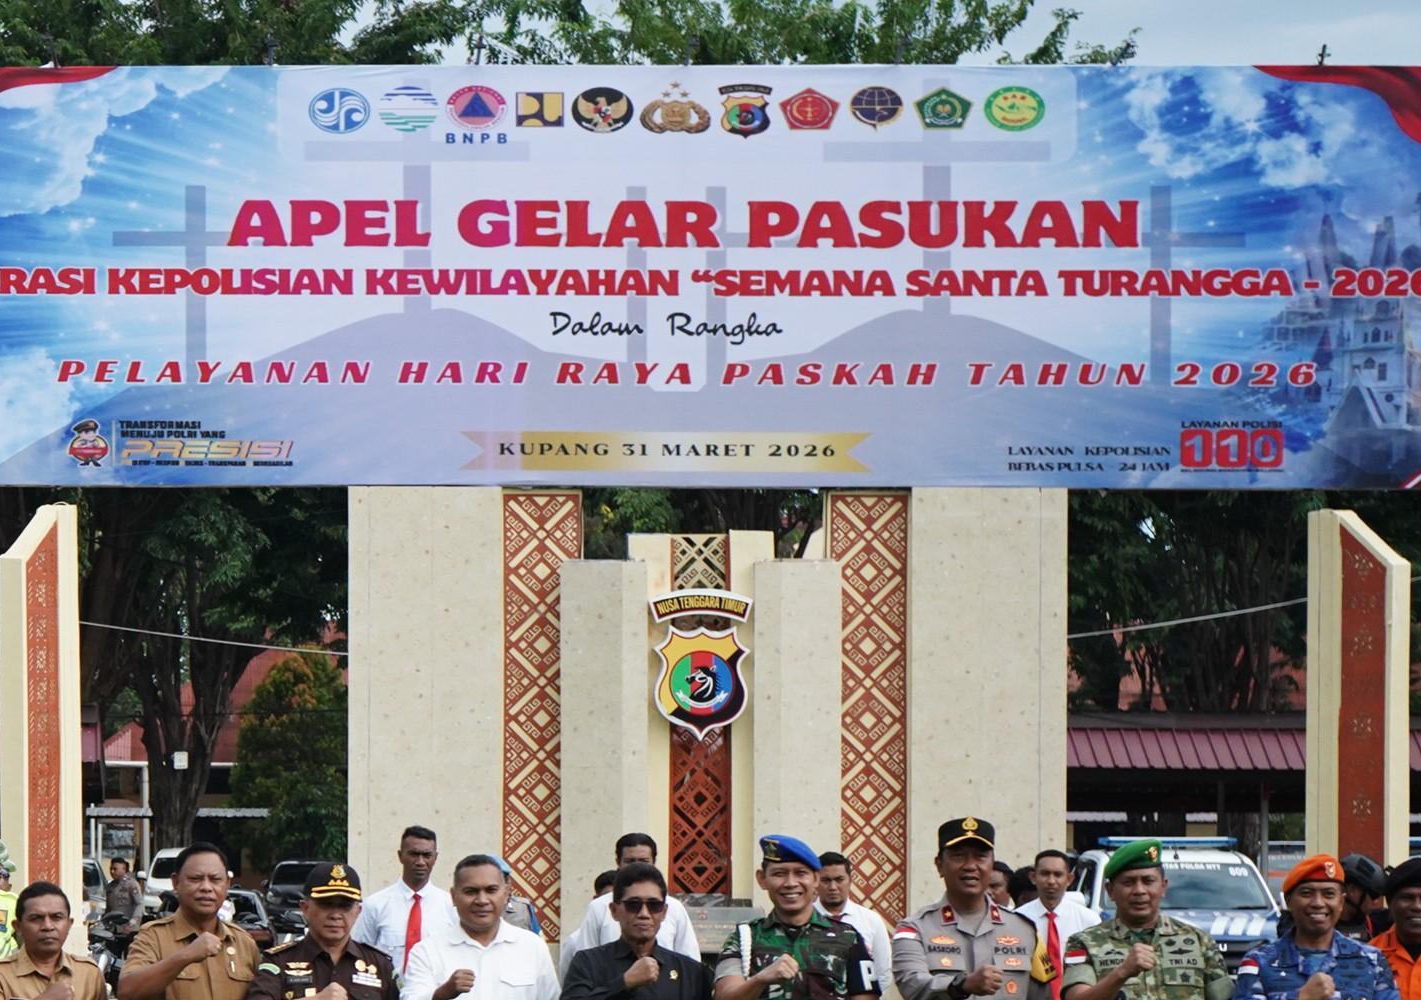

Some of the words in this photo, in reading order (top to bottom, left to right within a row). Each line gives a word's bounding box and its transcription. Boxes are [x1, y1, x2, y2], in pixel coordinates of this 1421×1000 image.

[446, 133, 507, 144] BNPB
[227, 199, 432, 247] APEL
[457, 199, 720, 248] GELAR
[748, 200, 1139, 249] PASUKAN
[107, 267, 354, 295] KEPOLISIAN
[365, 268, 680, 296] KEWILAYAHAN
[906, 269, 1048, 297] SANTA
[1057, 269, 1293, 297] TURANGGA
[549, 311, 644, 336] Dalam
[666, 311, 783, 345] Rangka
[57, 360, 370, 383] PELAYANAN
[397, 361, 528, 384] HARI
[556, 362, 692, 385] RAYA
[722, 363, 937, 386] PASKAH
[968, 363, 1146, 386] TAHUN
[1172, 362, 1317, 386] 2026
[119, 420, 201, 430] TRANSFORMASI
[1180, 421, 1240, 429] LAYANAN
[1242, 421, 1283, 429] POLISI
[120, 430, 165, 438] MENUJU
[167, 430, 197, 438] POLRI
[199, 430, 226, 438] YANG
[121, 439, 293, 459] PRESISI
[499, 442, 609, 457] KUPANG
[622, 443, 647, 457] 31
[661, 443, 756, 457] MARET
[768, 444, 836, 457] 2026
[1008, 446, 1074, 456] LAYANAN
[1084, 446, 1172, 456] KEPOLISIAN
[1183, 433, 1280, 463] 110
[1008, 462, 1055, 472] BEBAS
[1057, 462, 1104, 472] PULSA
[1118, 463, 1137, 472] 24
[1140, 462, 1170, 472] JAM
[656, 599, 680, 615] NUSA
[680, 595, 721, 609] TENGGARA
[721, 598, 747, 614] TIMUR
[994, 947, 1027, 955] POLRI
